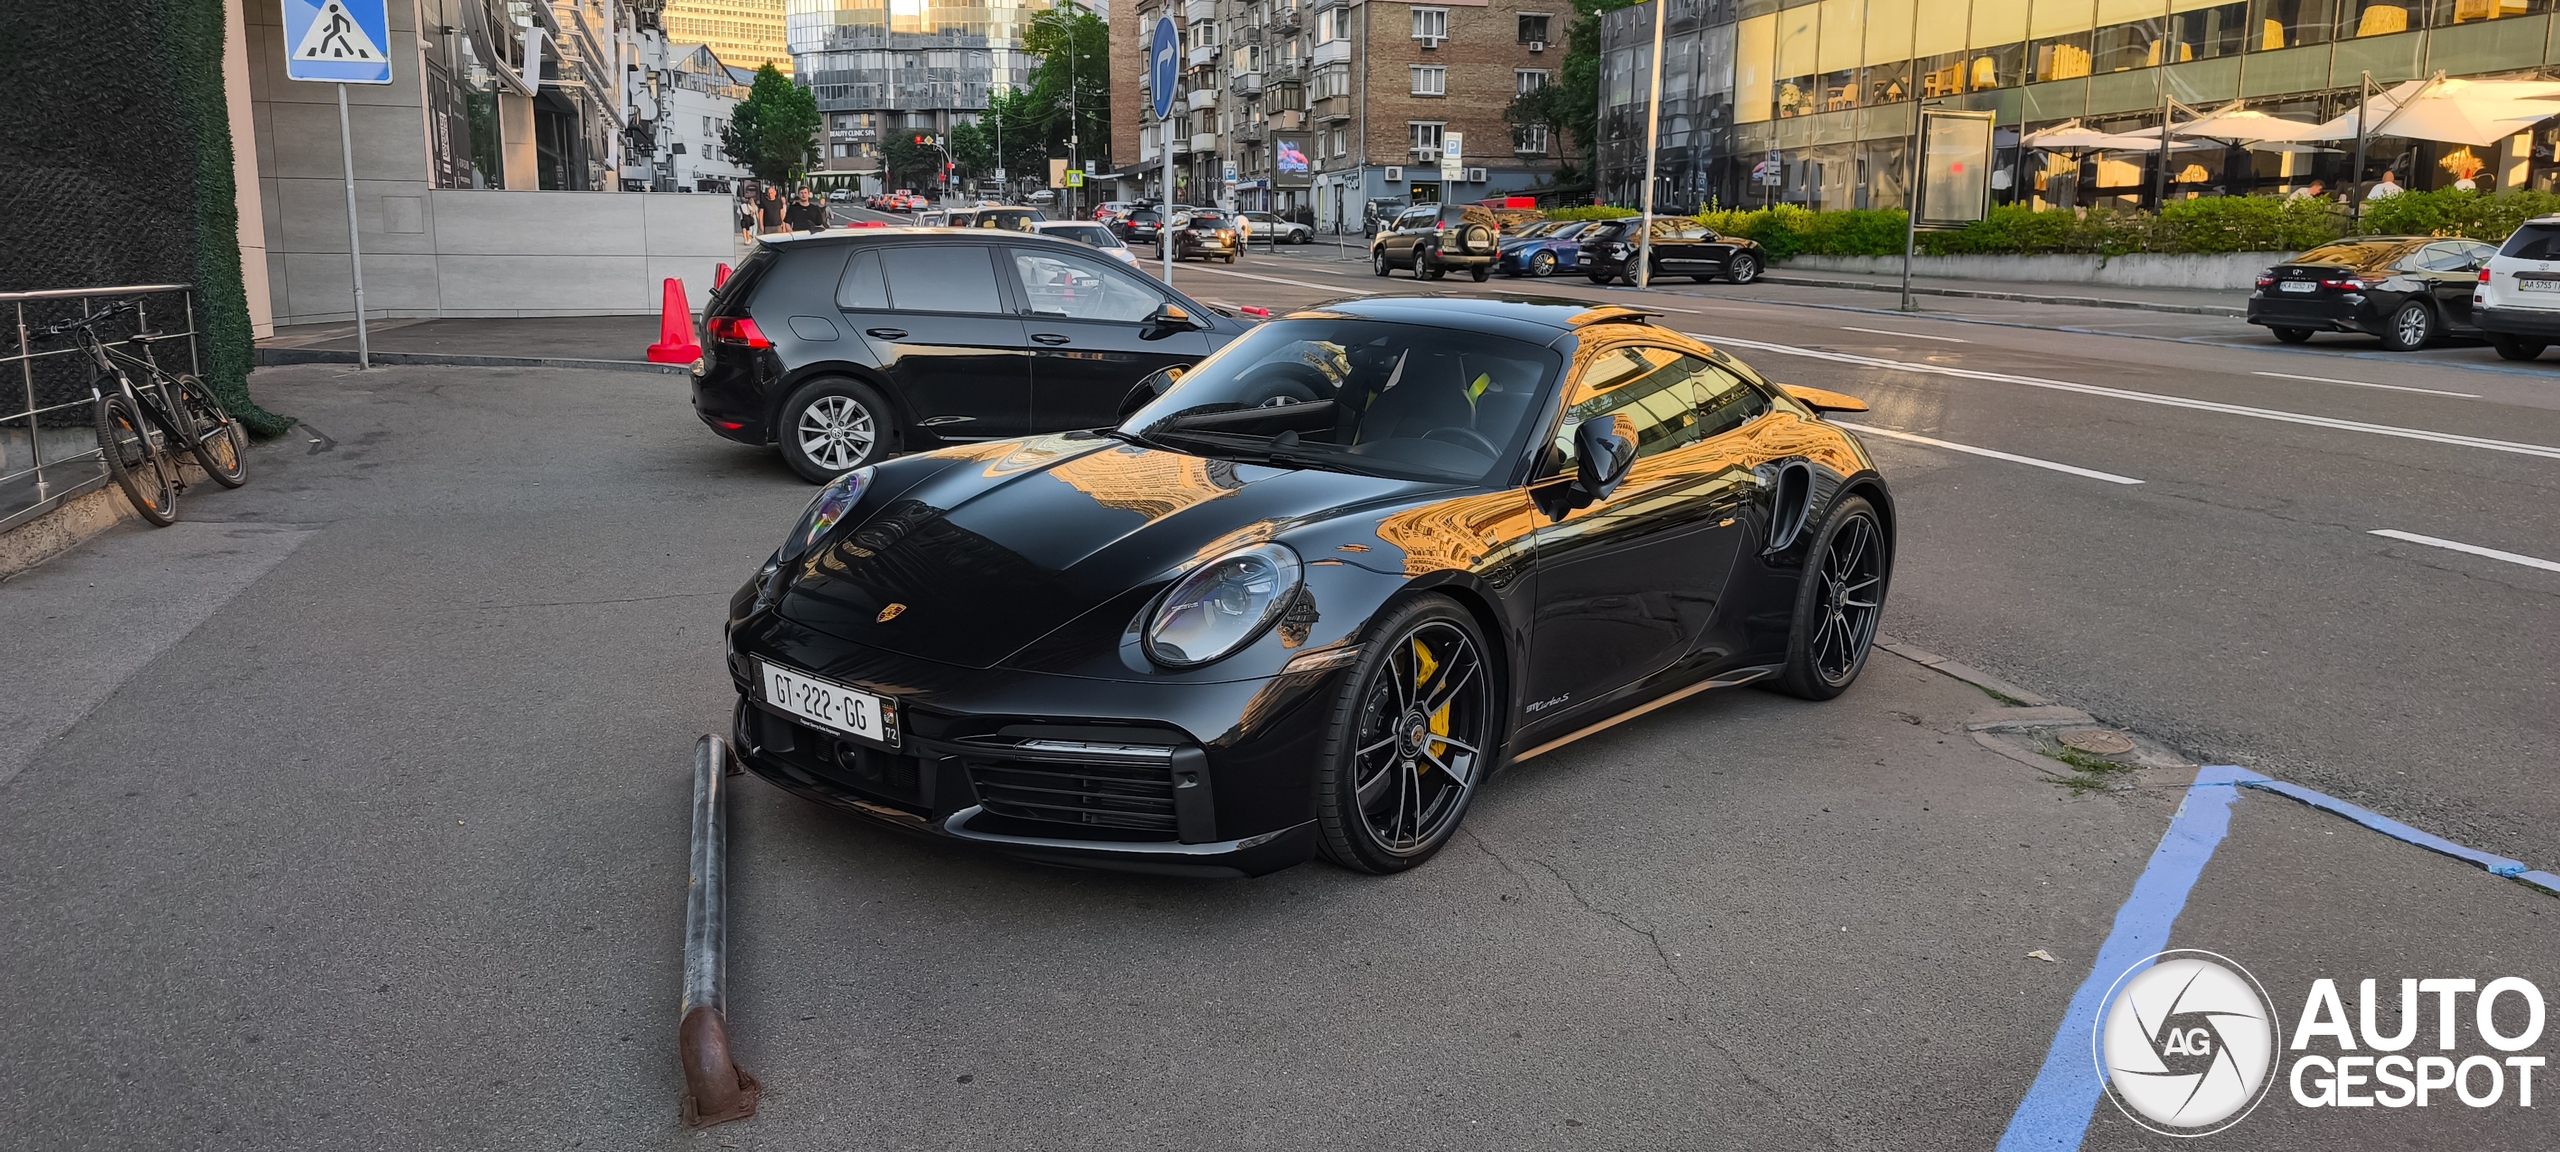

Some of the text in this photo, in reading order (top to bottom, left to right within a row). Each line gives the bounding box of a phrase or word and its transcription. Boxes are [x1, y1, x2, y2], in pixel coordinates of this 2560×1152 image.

[1448, 141, 1456, 153] P
[1226, 169, 1234, 179] P
[885, 727, 897, 740] 72
